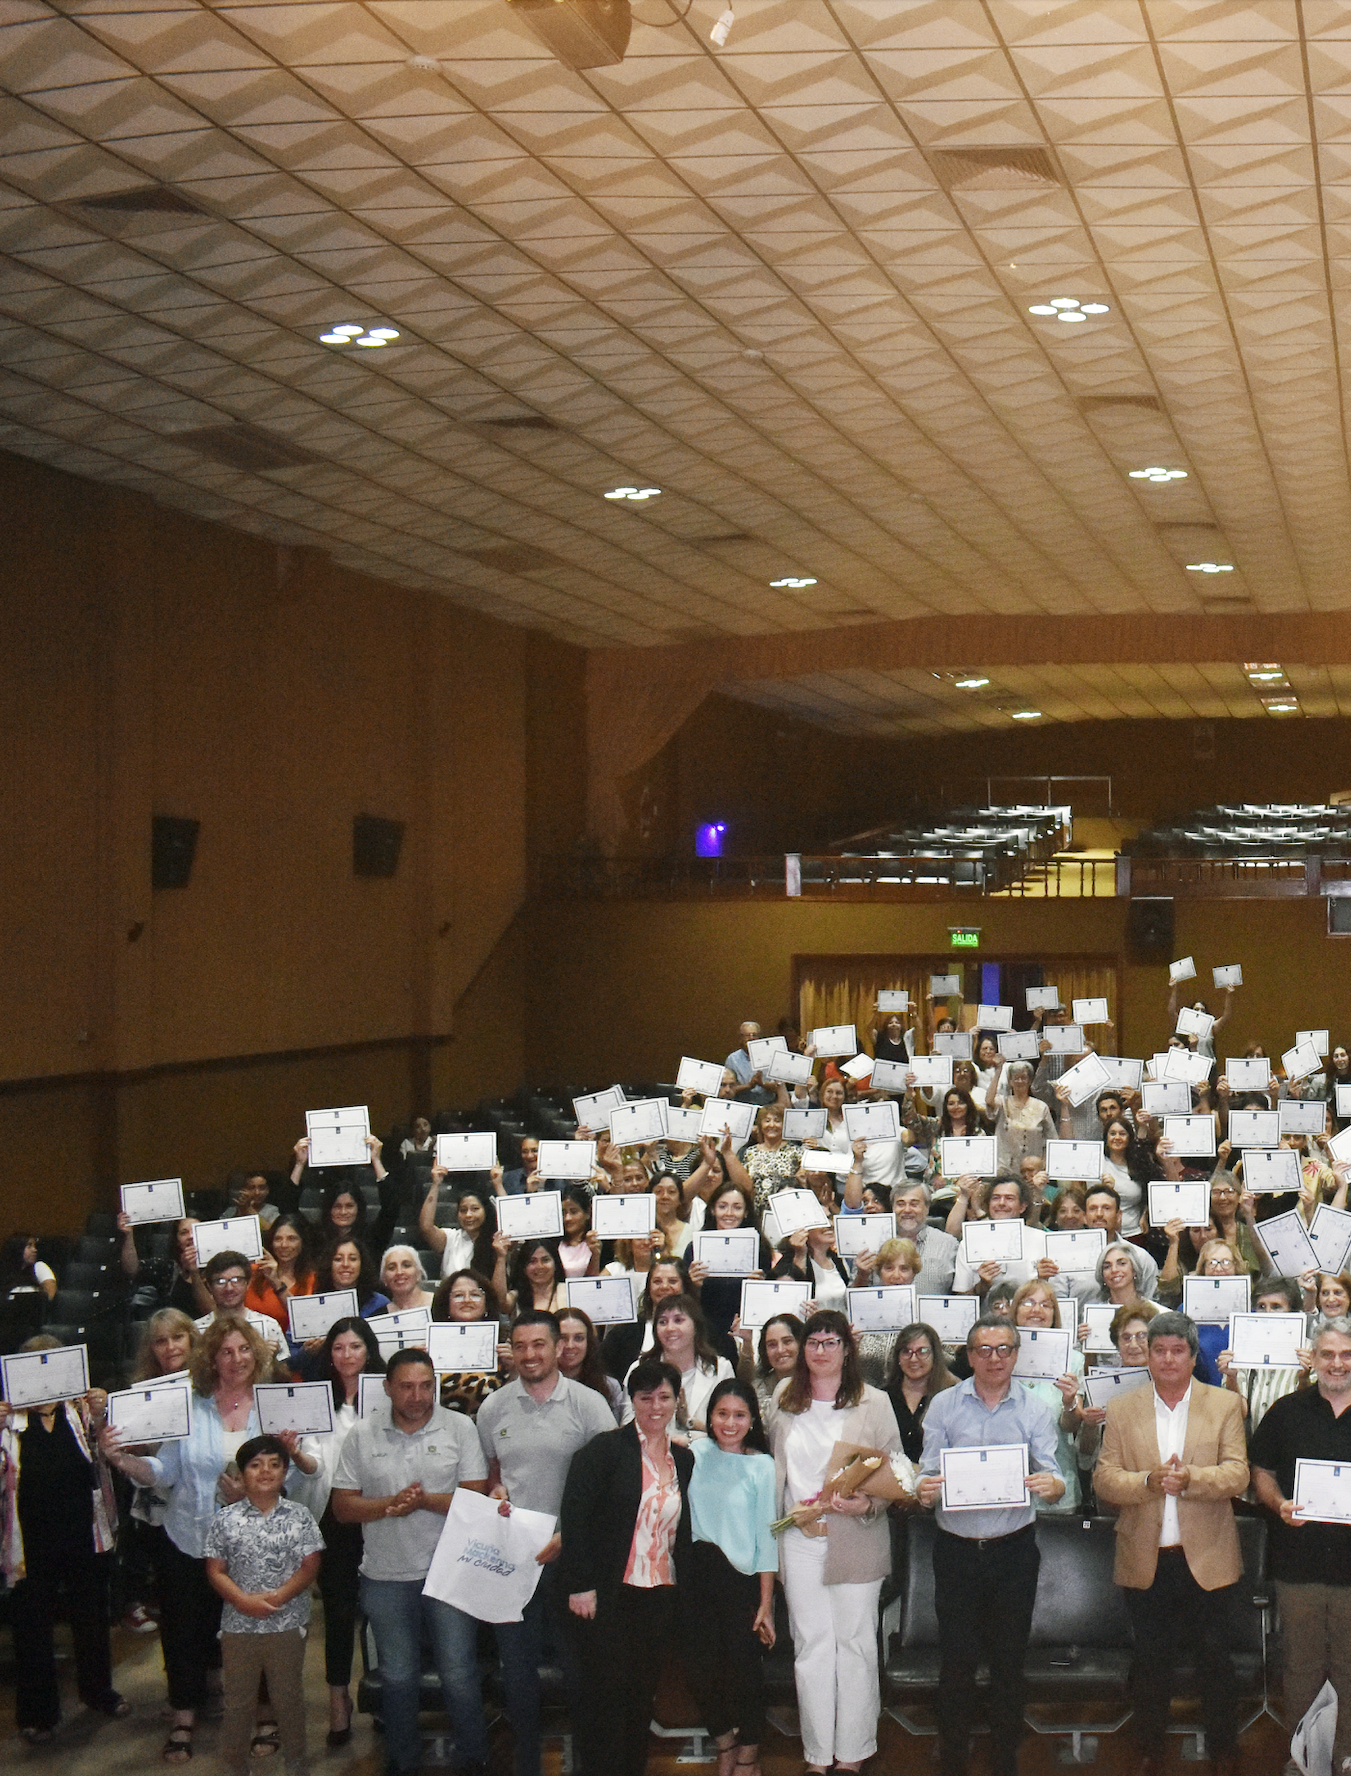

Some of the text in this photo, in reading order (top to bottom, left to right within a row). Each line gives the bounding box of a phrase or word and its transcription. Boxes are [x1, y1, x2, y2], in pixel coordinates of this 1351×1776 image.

[952, 934, 978, 943] SALIDA
[467, 1537, 500, 1556] Vicuña
[474, 1558, 516, 1577] ciudad
